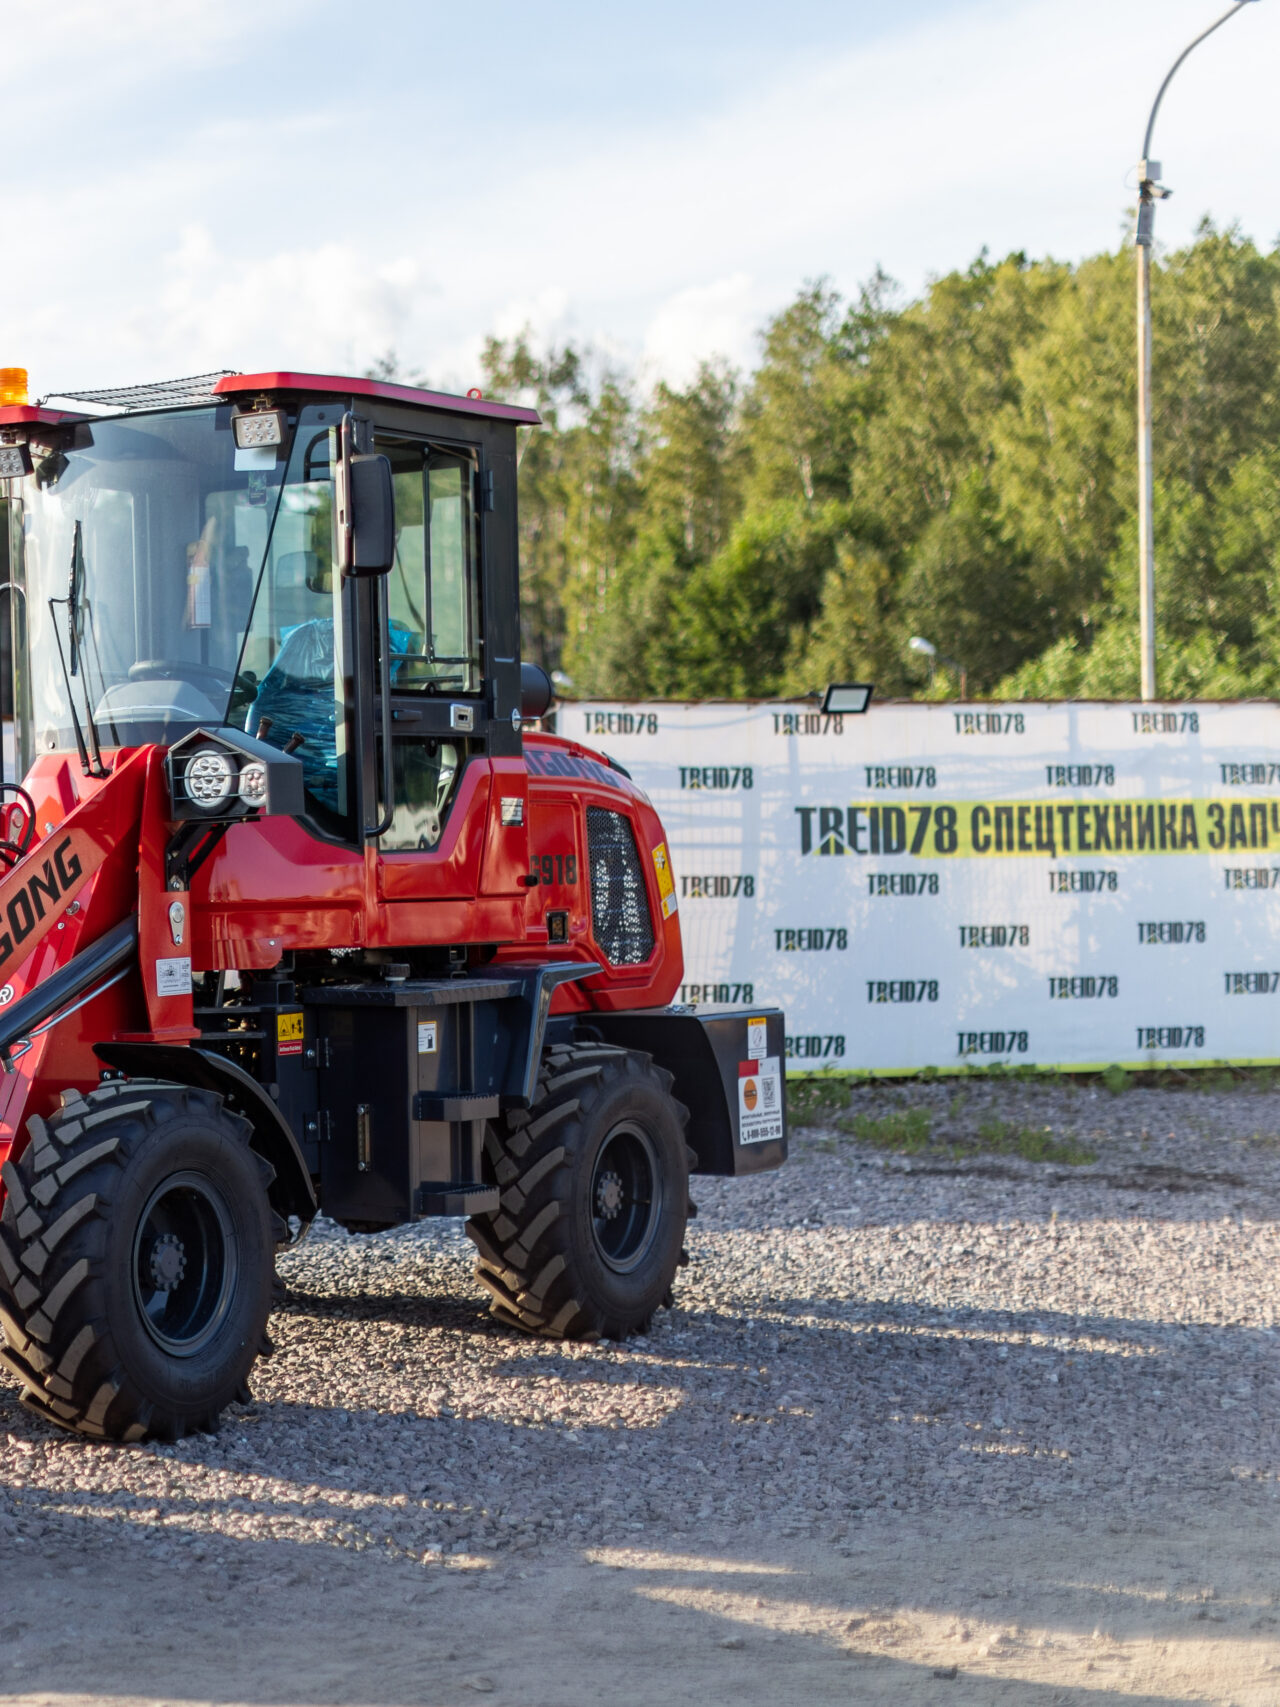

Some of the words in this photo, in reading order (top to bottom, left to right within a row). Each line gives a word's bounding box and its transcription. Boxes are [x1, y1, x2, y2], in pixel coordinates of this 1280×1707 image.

[583, 712, 659, 735] TREID78
[772, 711, 844, 735] TREID78
[953, 712, 1026, 735] TREID78
[1131, 711, 1200, 734] TREID78
[523, 750, 621, 789] IGONG
[678, 766, 754, 790] TREID78
[864, 766, 937, 789] TREID78
[1044, 764, 1116, 787] TREID78
[795, 806, 958, 857] TREID78
[971, 803, 1199, 859] СПЕЦТЕХНИКА
[680, 875, 756, 899] TREID78
[866, 872, 940, 896] TREID78
[1047, 870, 1119, 893] TREID78
[1224, 867, 1280, 890] TREID7
[774, 927, 848, 952] TREID78
[958, 924, 1030, 948] TREID78
[1136, 921, 1207, 944] TREID78
[680, 982, 754, 1004] TREID78
[866, 979, 940, 1003] TREID78
[1048, 975, 1120, 999] TREID78
[1224, 971, 1280, 995] TREID7
[784, 1036, 846, 1058] REID78
[957, 1030, 1030, 1054] TREID78
[1135, 1025, 1206, 1049] TREID78
